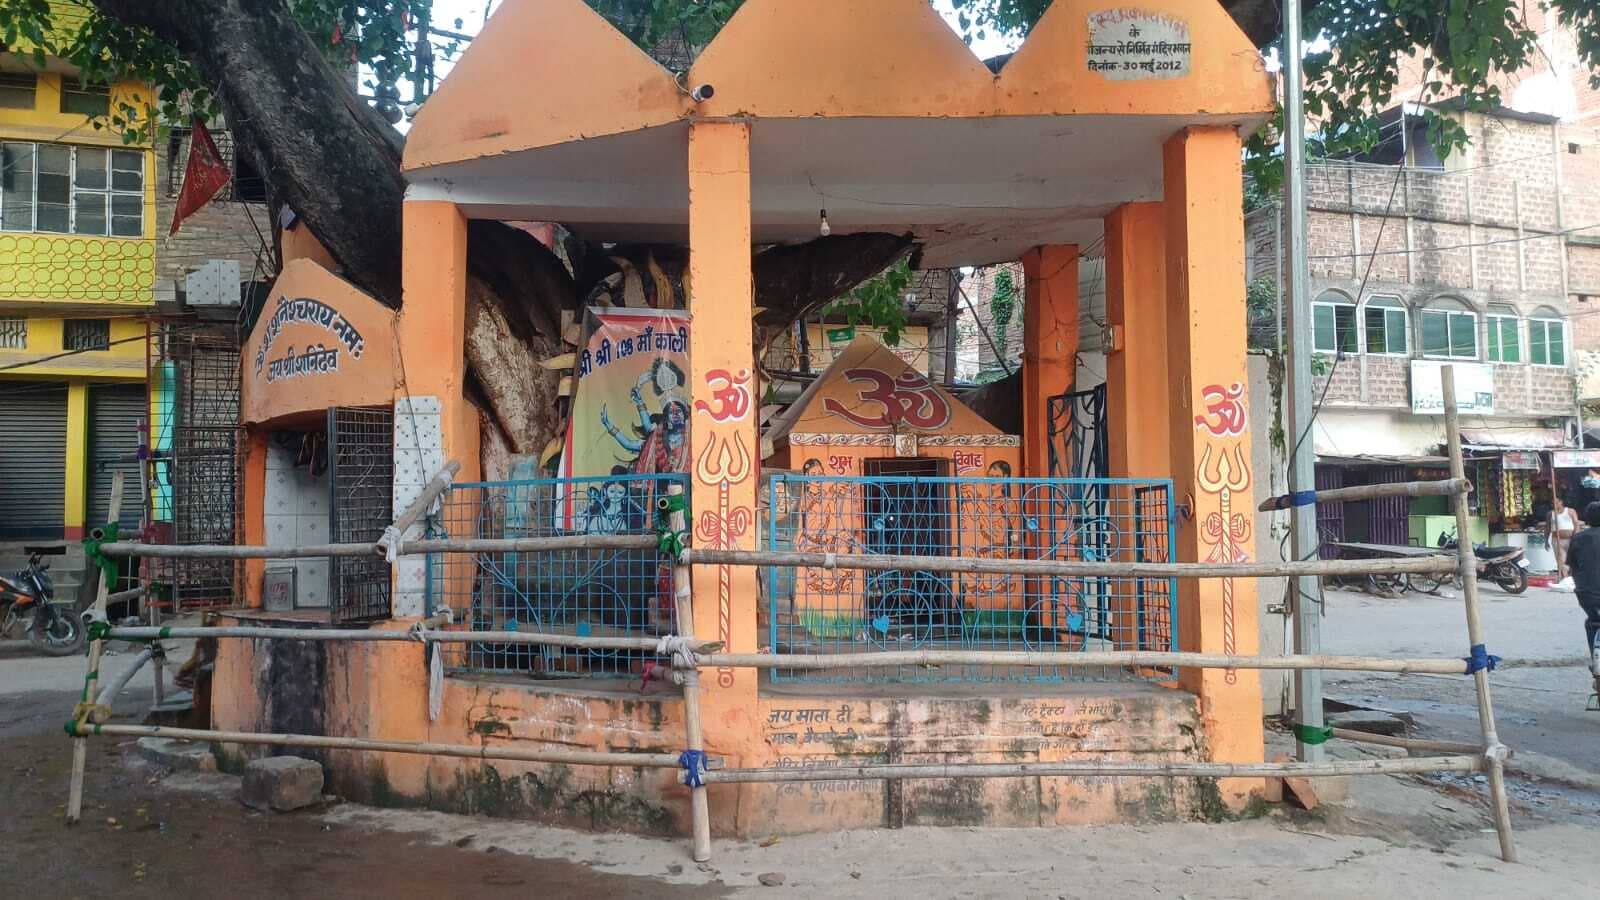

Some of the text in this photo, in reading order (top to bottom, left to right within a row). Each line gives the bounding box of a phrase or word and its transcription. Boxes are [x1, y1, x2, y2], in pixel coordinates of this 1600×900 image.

[1128, 23, 1141, 38] के
[1122, 61, 1137, 70] 30
[1139, 59, 1154, 73] मई
[1156, 60, 1182, 71] 2012
[595, 339, 611, 369] श्री
[616, 337, 634, 360] 108
[637, 325, 653, 353] माँ
[655, 325, 688, 353] काली
[829, 455, 853, 475] शुभ
[953, 449, 984, 469] विवाह
[768, 704, 853, 724] जय माता दी
